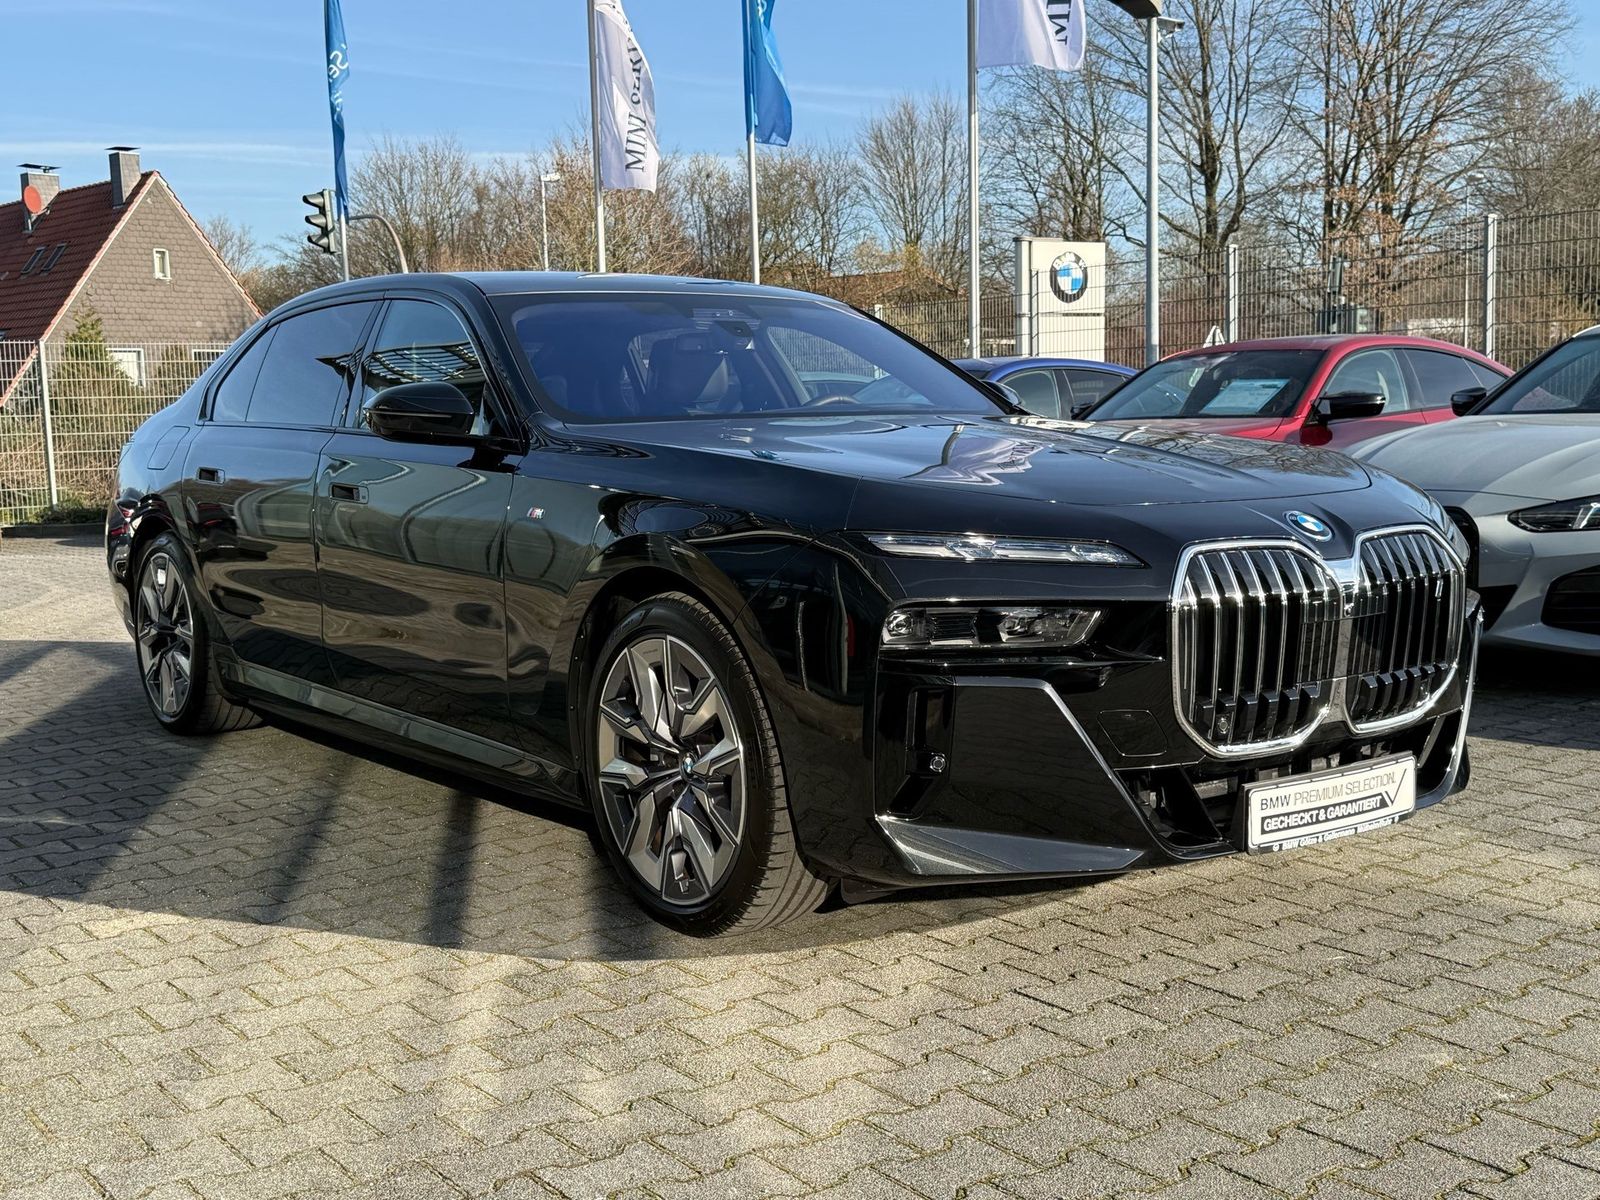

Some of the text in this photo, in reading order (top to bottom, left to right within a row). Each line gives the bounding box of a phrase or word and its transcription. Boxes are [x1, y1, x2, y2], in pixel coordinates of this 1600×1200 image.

[625, 113, 647, 172] MINI
[1261, 794, 1292, 811] BMW
[1293, 785, 1343, 806] PREMIUM
[1263, 795, 1383, 832] GECHECKT & GARANTIERT
